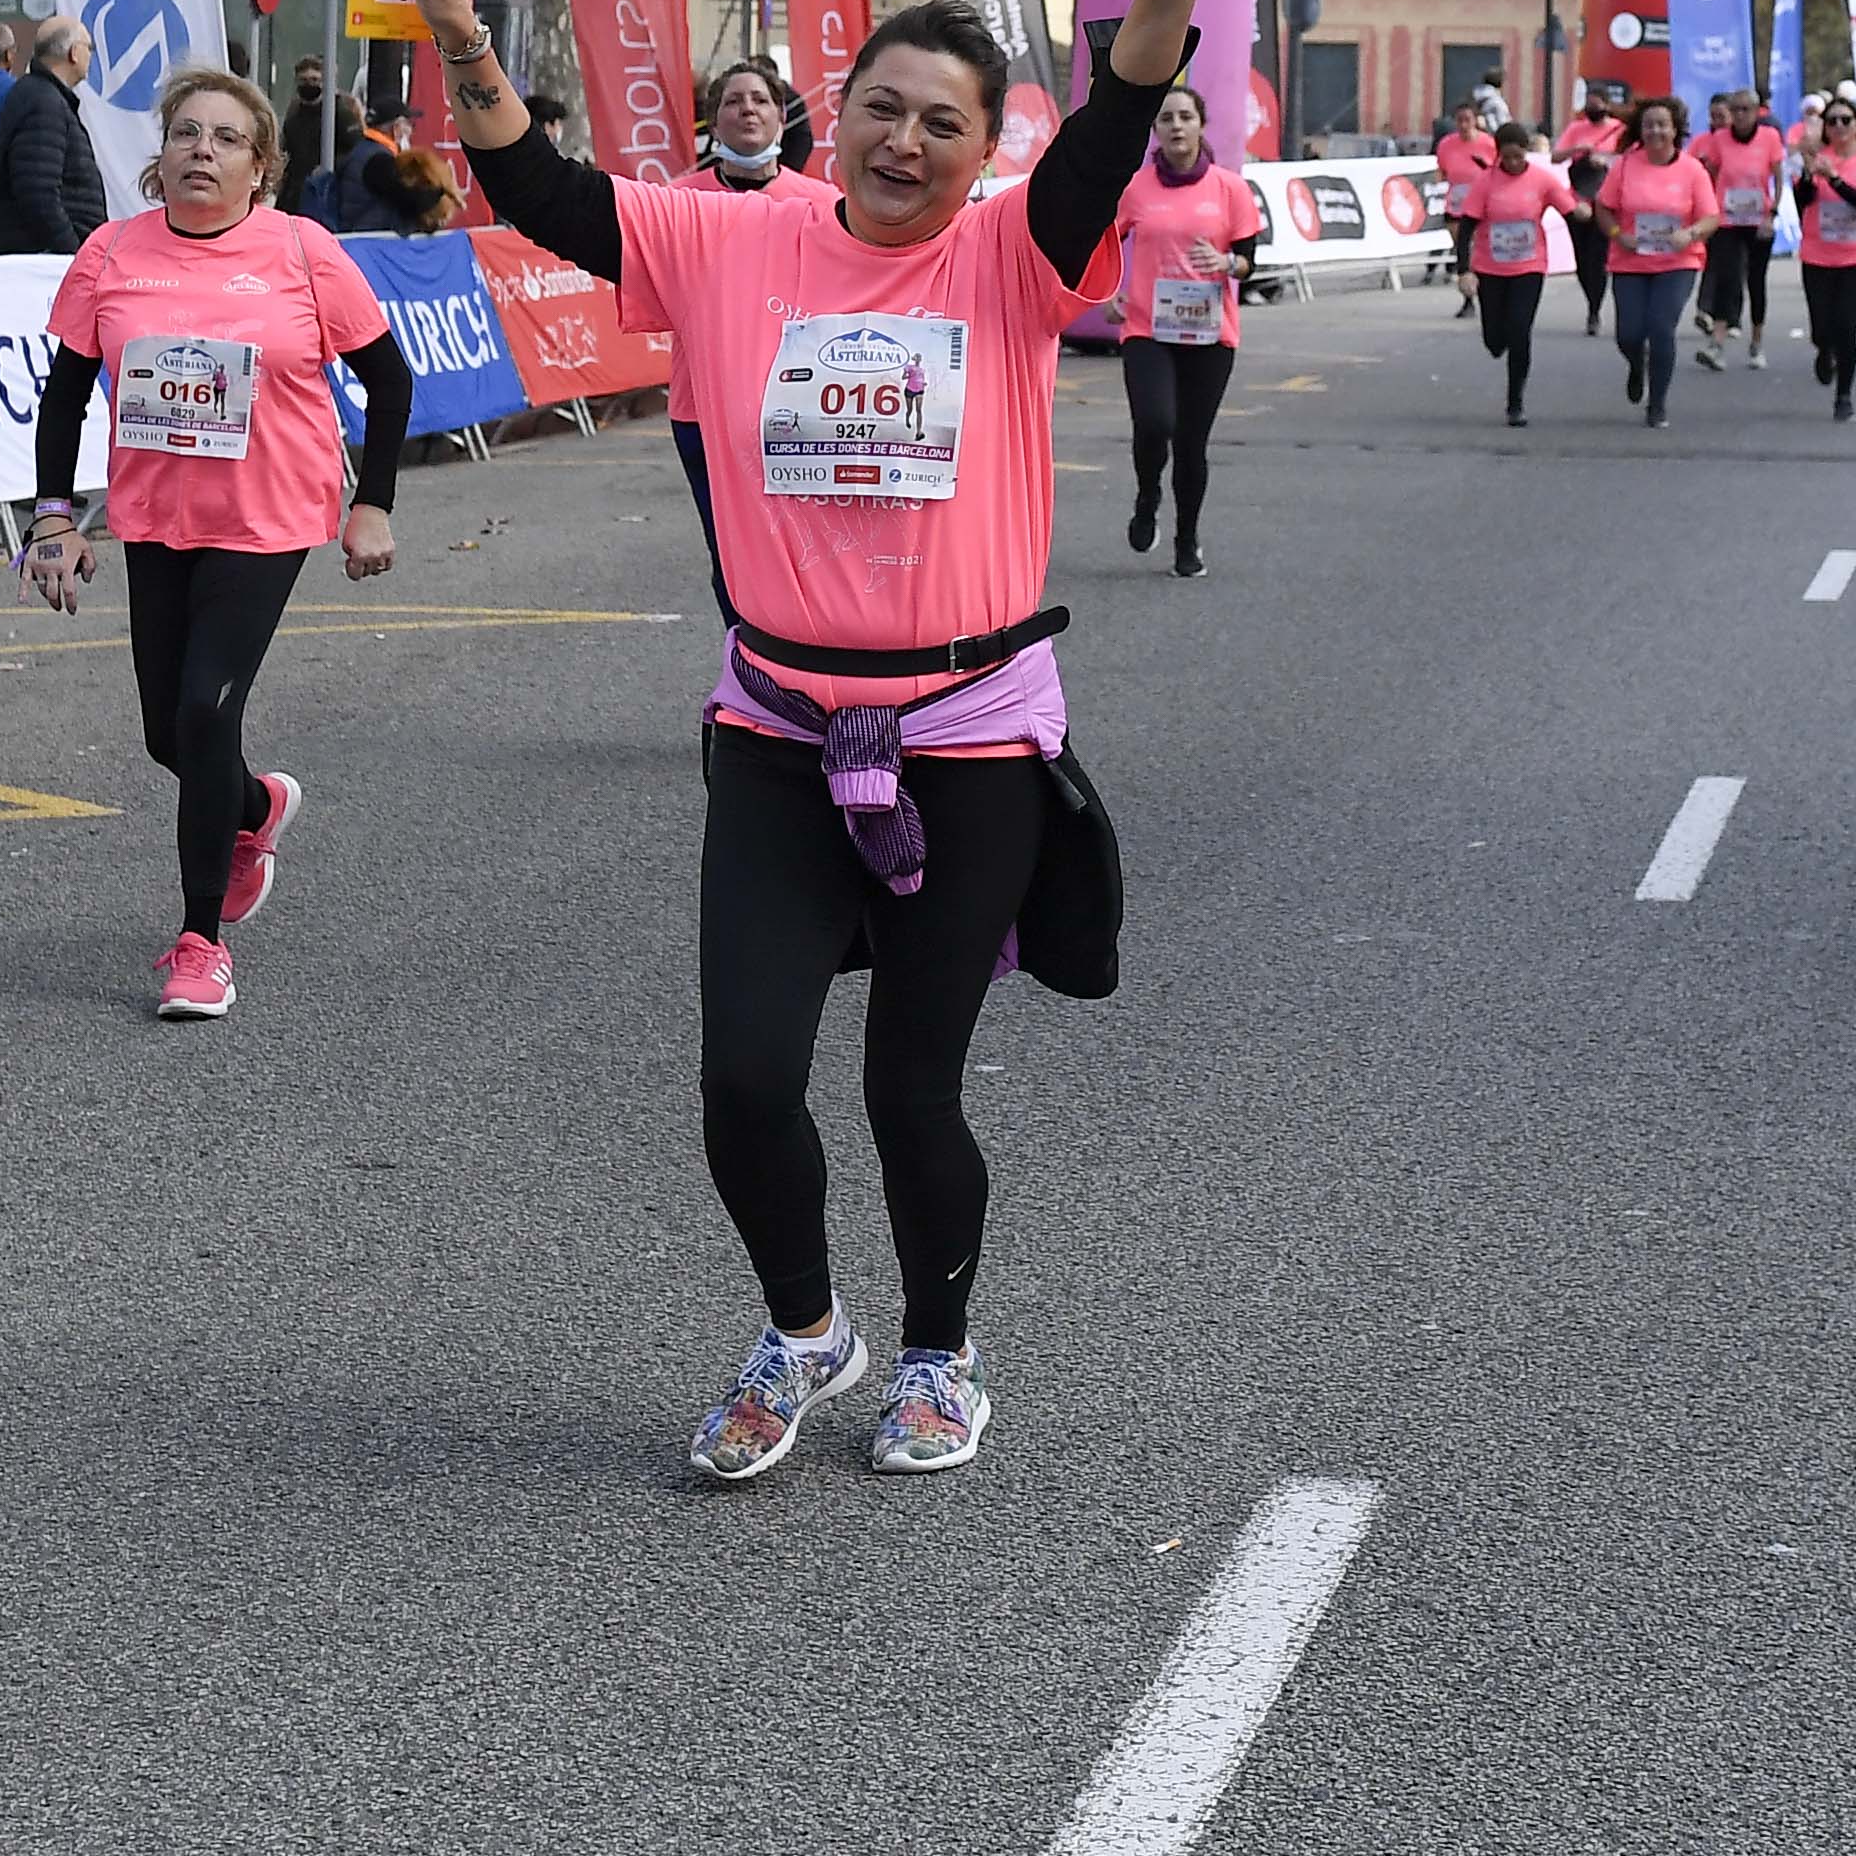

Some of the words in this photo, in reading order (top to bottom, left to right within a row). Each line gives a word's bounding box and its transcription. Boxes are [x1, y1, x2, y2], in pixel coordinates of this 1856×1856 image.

[824, 345, 901, 364] ASTURIANA
[160, 381, 211, 404] 016
[820, 383, 900, 416] 016
[835, 424, 876, 440] 9247
[769, 443, 800, 454] CURSA
[802, 443, 815, 454] DE
[817, 443, 836, 454] LES
[837, 444, 871, 455] DONES
[872, 445, 888, 455] DE
[889, 445, 951, 460] BARCELONA
[771, 467, 827, 482] OYSHO
